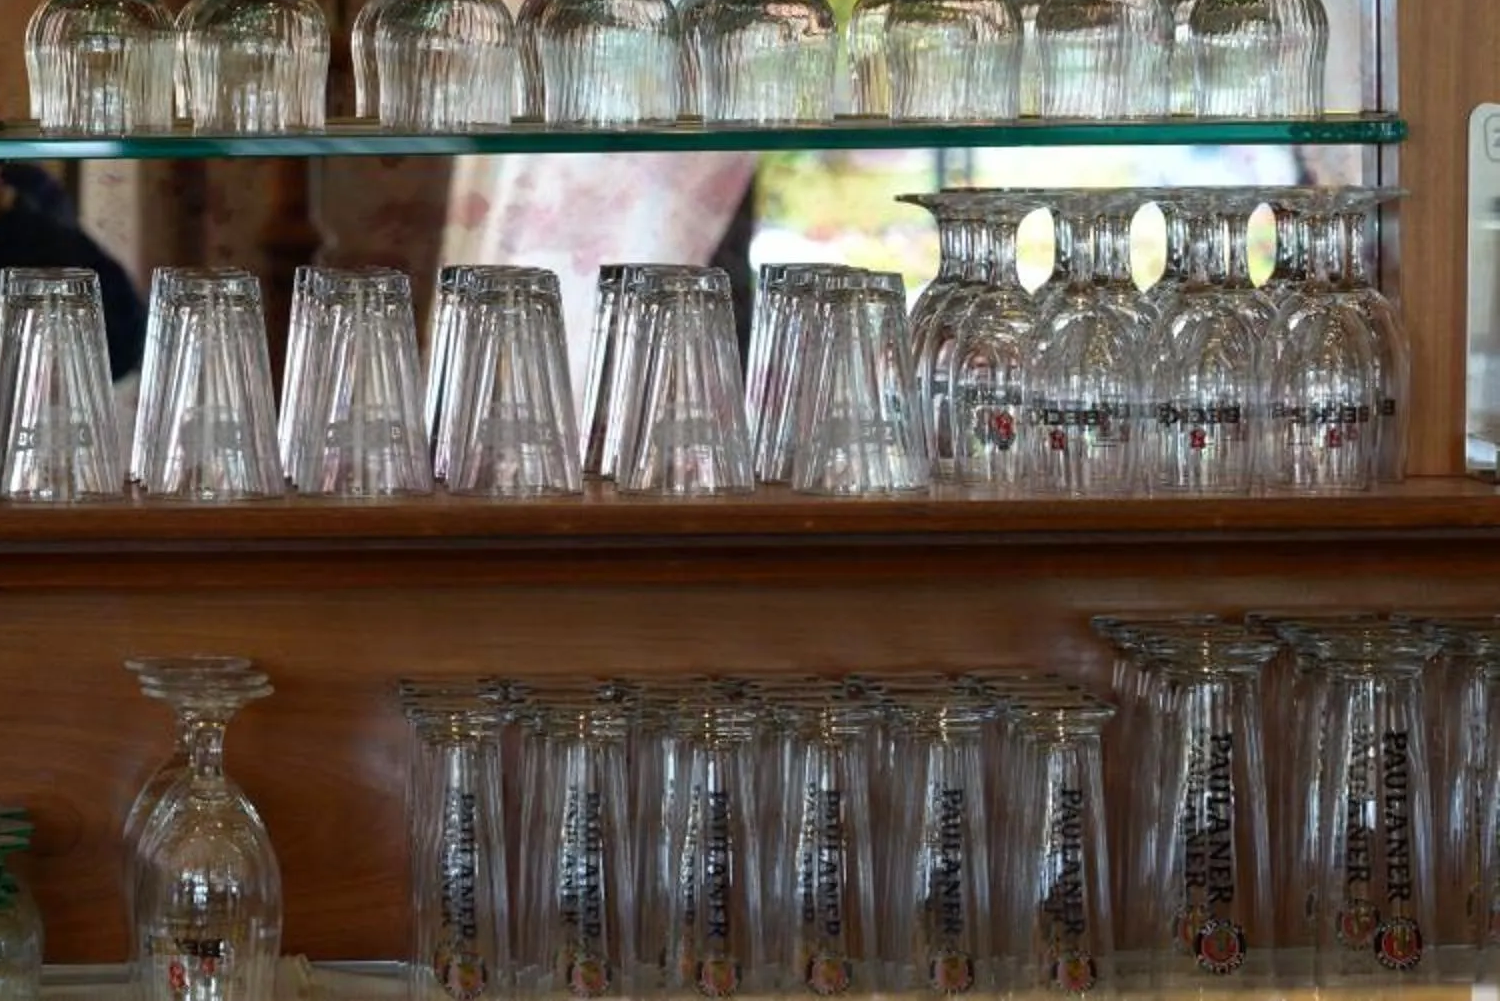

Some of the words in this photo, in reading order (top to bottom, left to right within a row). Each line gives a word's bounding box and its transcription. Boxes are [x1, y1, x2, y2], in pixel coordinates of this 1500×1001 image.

[818, 791, 841, 936] PAULANER
[942, 789, 964, 935] PAULANER
[1061, 789, 1086, 936] PAULANER
[1207, 733, 1234, 904] PAULANER
[1384, 731, 1412, 902] PAULANER
